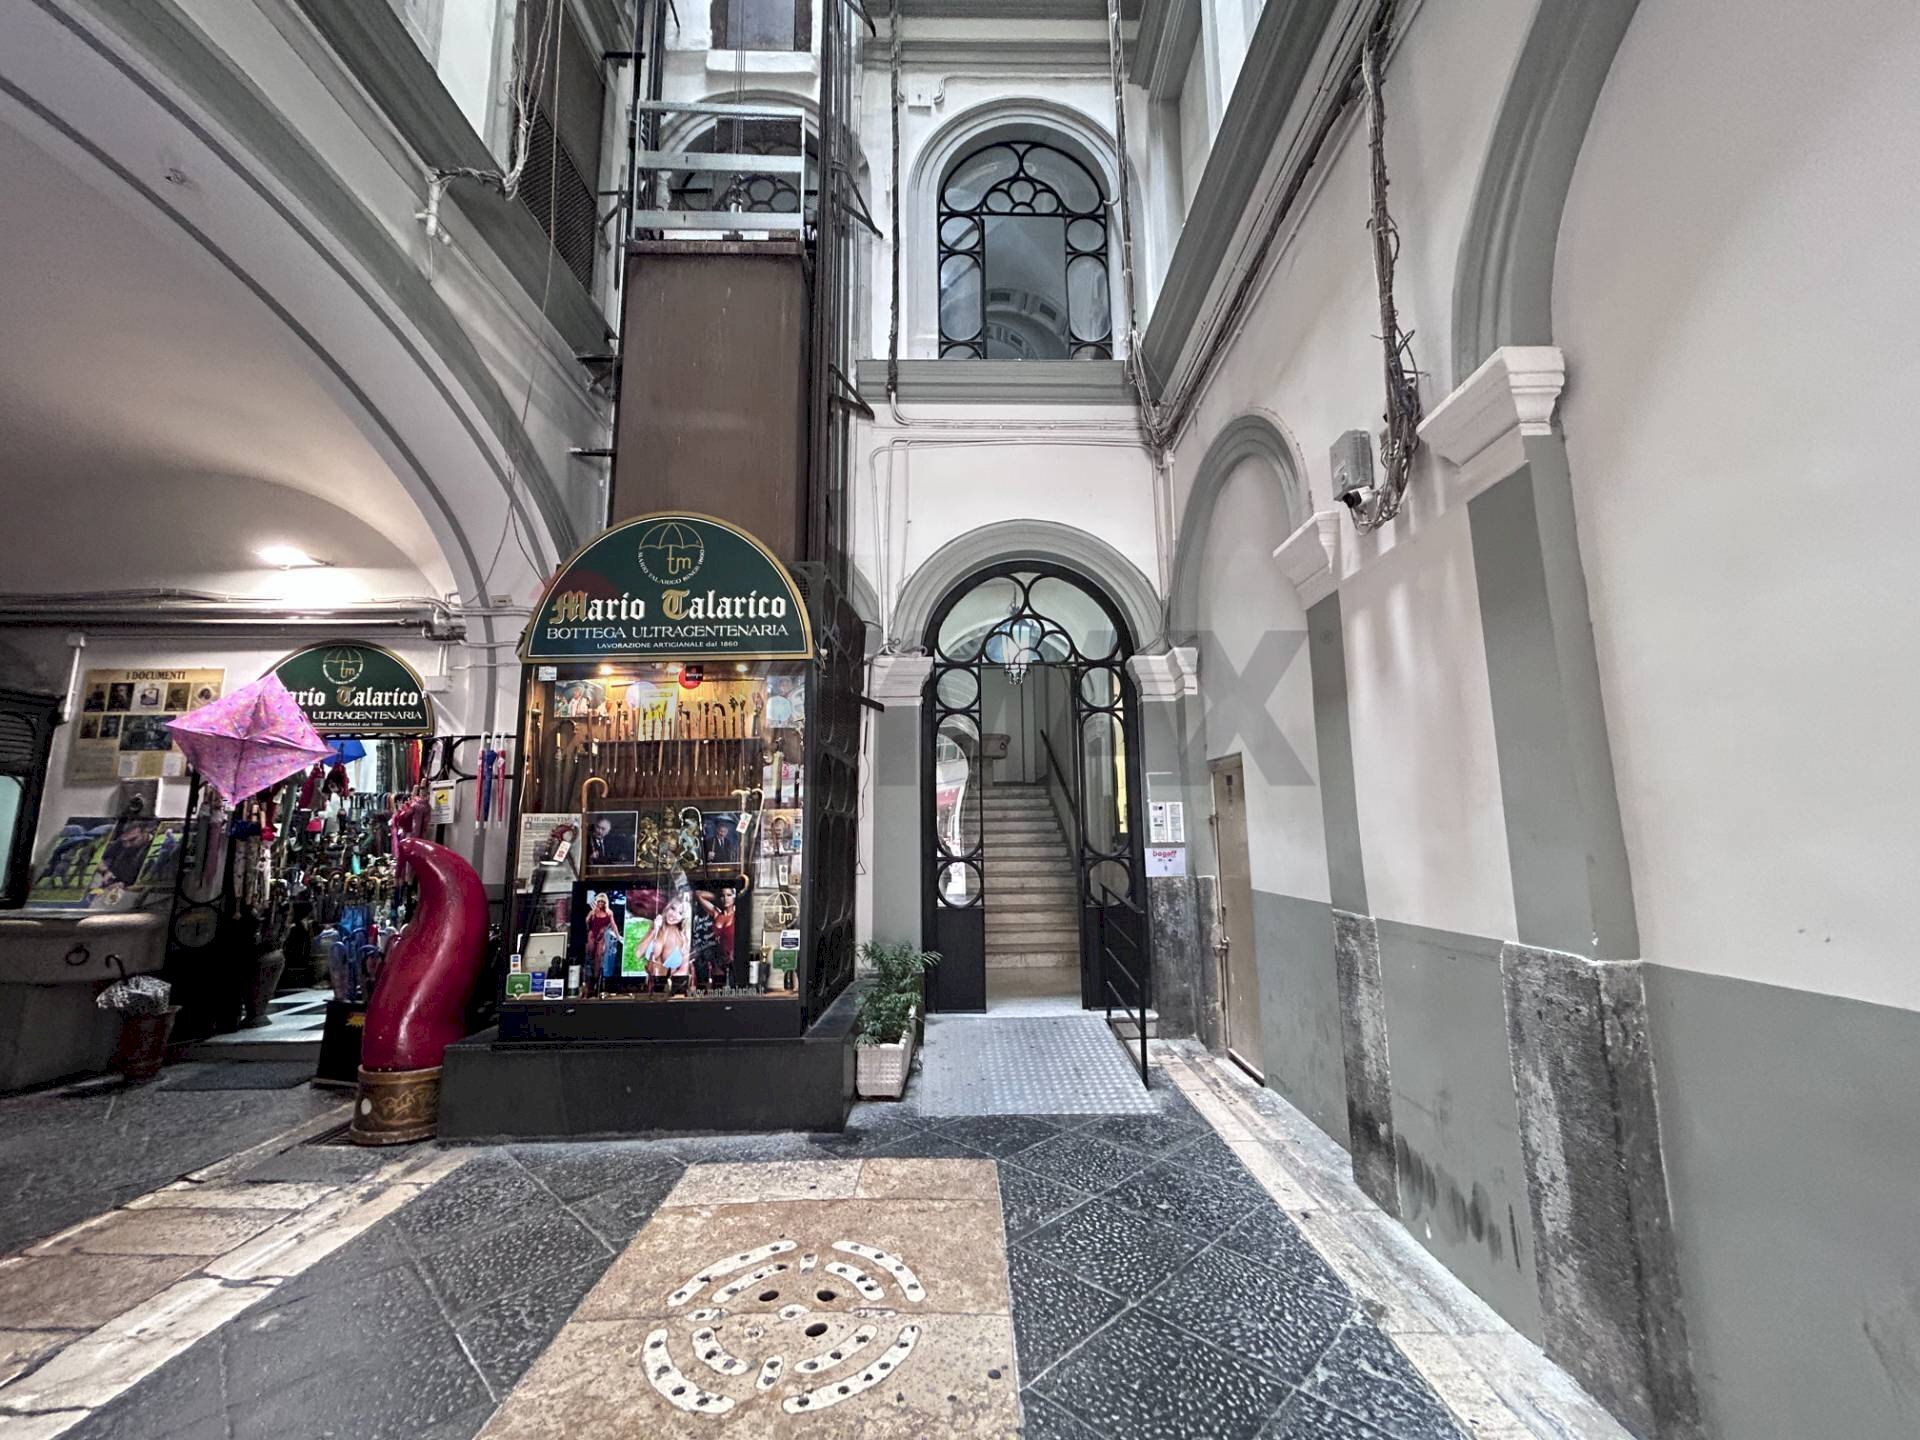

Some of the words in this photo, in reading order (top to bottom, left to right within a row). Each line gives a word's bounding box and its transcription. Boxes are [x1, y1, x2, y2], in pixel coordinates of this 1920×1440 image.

[549, 589, 645, 624] Mario
[661, 588, 787, 621] Talarico
[547, 627, 627, 640] BOTTEGA
[132, 671, 186, 680] DOCUMENTI
[288, 686, 326, 707] ario
[336, 686, 418, 707] Talarico
